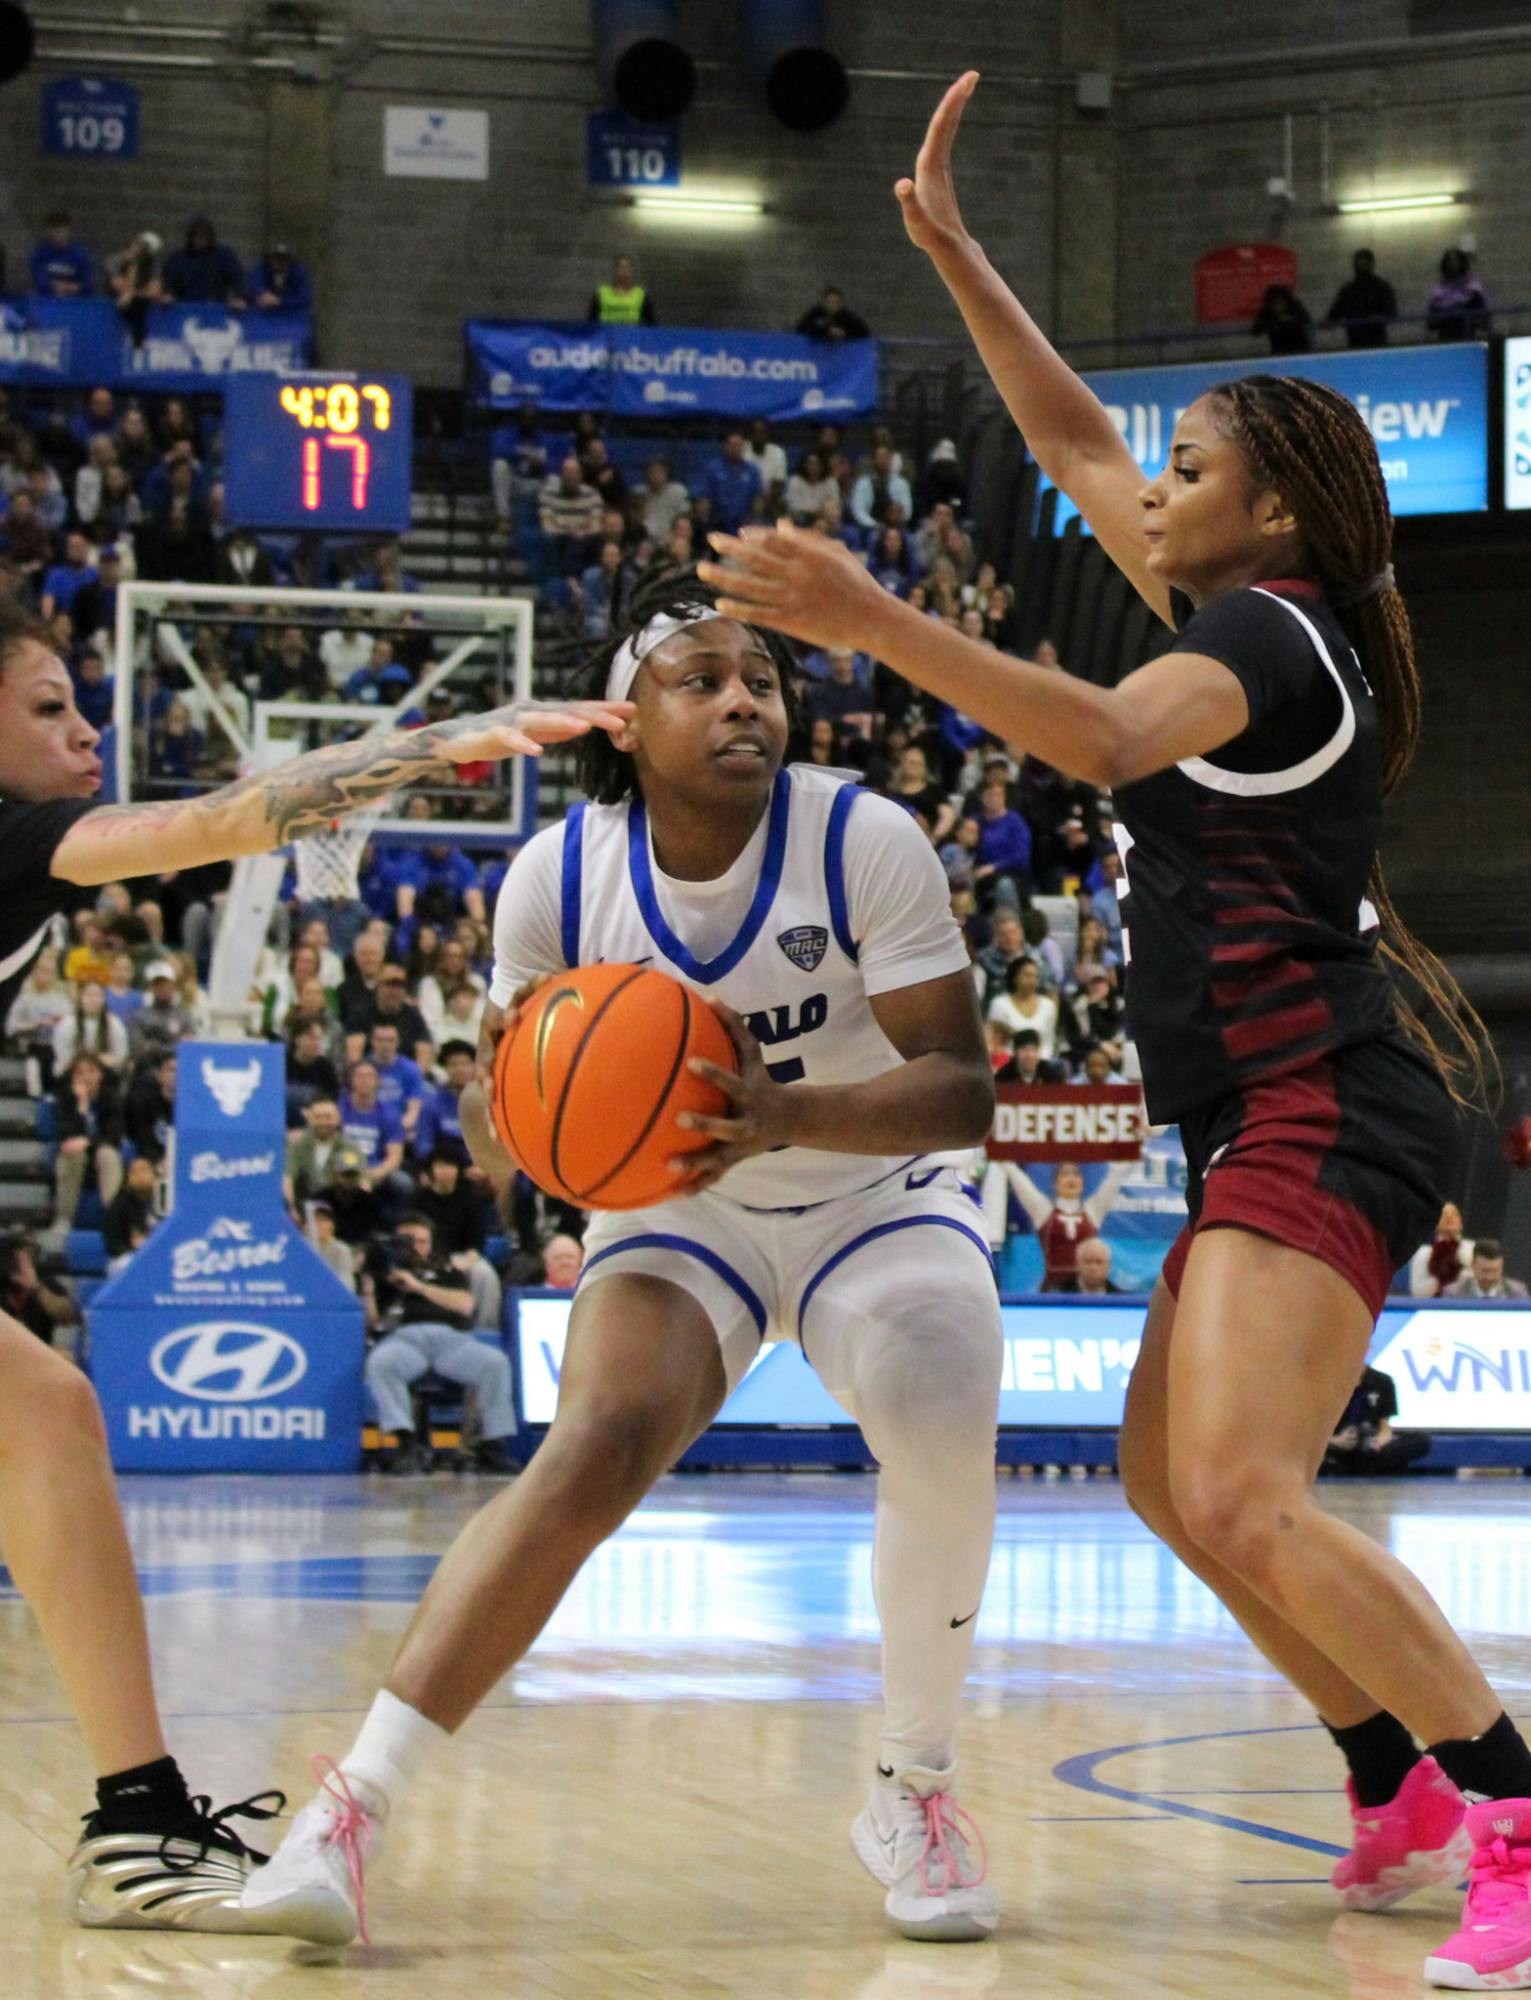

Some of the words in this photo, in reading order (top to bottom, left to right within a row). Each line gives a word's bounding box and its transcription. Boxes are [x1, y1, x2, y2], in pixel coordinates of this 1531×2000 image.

[59, 117, 125, 151] 109
[607, 148, 665, 181] 110
[529, 342, 818, 382] audenbuffalo.com
[279, 384, 391, 434] 4:07
[303, 433, 370, 511] 17
[994, 1103, 1138, 1143] DEFENSE
[129, 1405, 326, 1439] HYUNDAI
